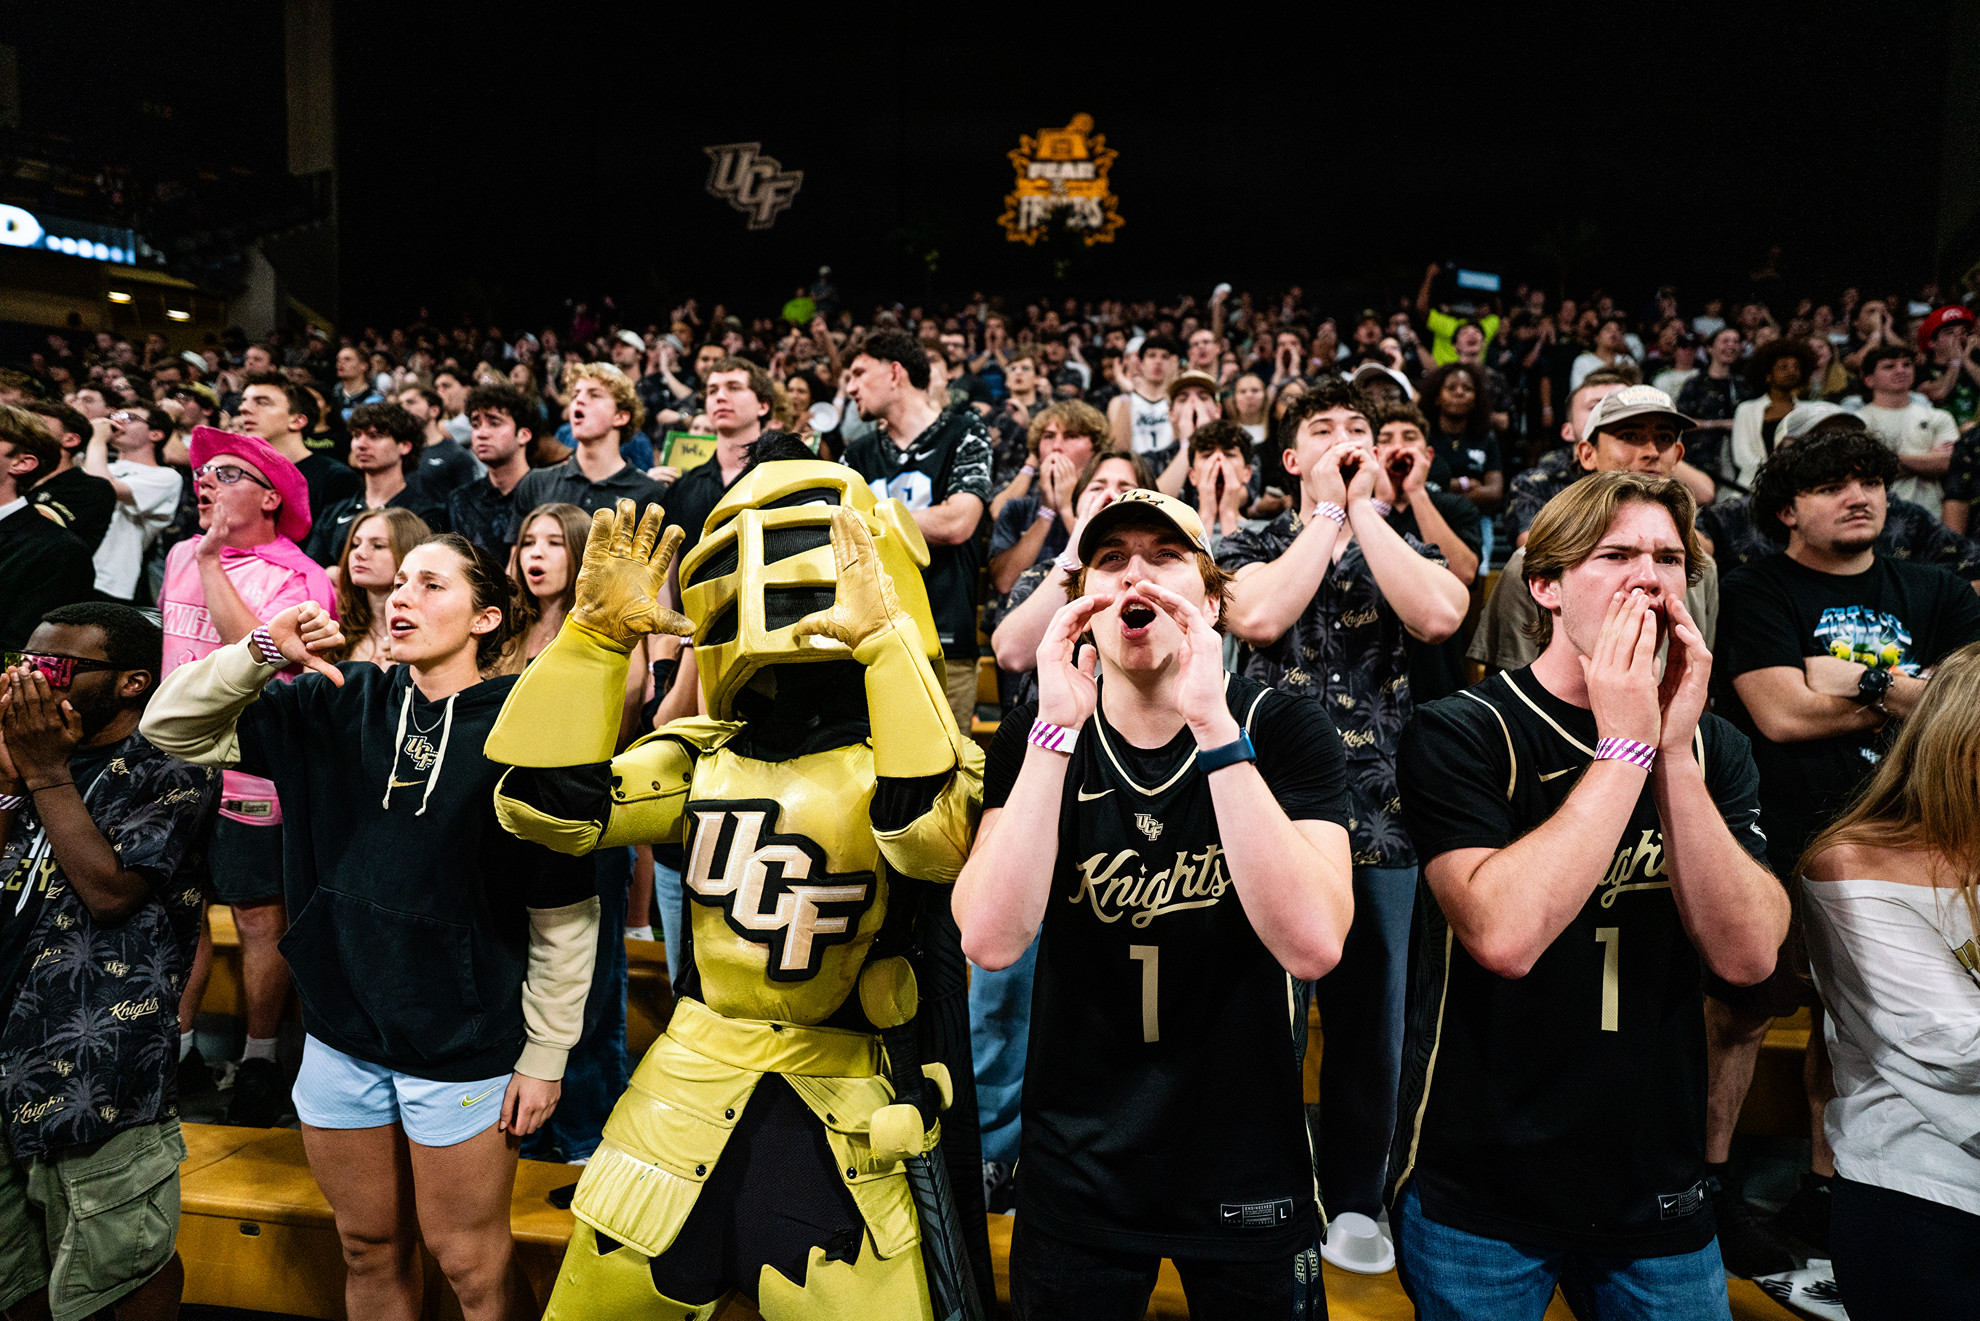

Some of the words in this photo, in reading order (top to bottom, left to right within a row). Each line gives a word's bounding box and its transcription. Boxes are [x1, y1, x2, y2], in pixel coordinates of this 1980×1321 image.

[704, 142, 804, 230] UCF
[1341, 609, 1379, 628] Knights
[405, 736, 439, 770] UCF
[1342, 730, 1375, 748] Knights
[1134, 813, 1164, 841] UCF
[684, 811, 869, 971] UCF
[1069, 844, 1232, 928] Knights
[104, 960, 130, 978] UCF
[1595, 927, 1620, 1032] 1
[1129, 945, 1160, 1042] 1
[109, 998, 159, 1021] Knights
[1280, 1207, 1287, 1218] L
[1296, 1253, 1305, 1282] UCF
